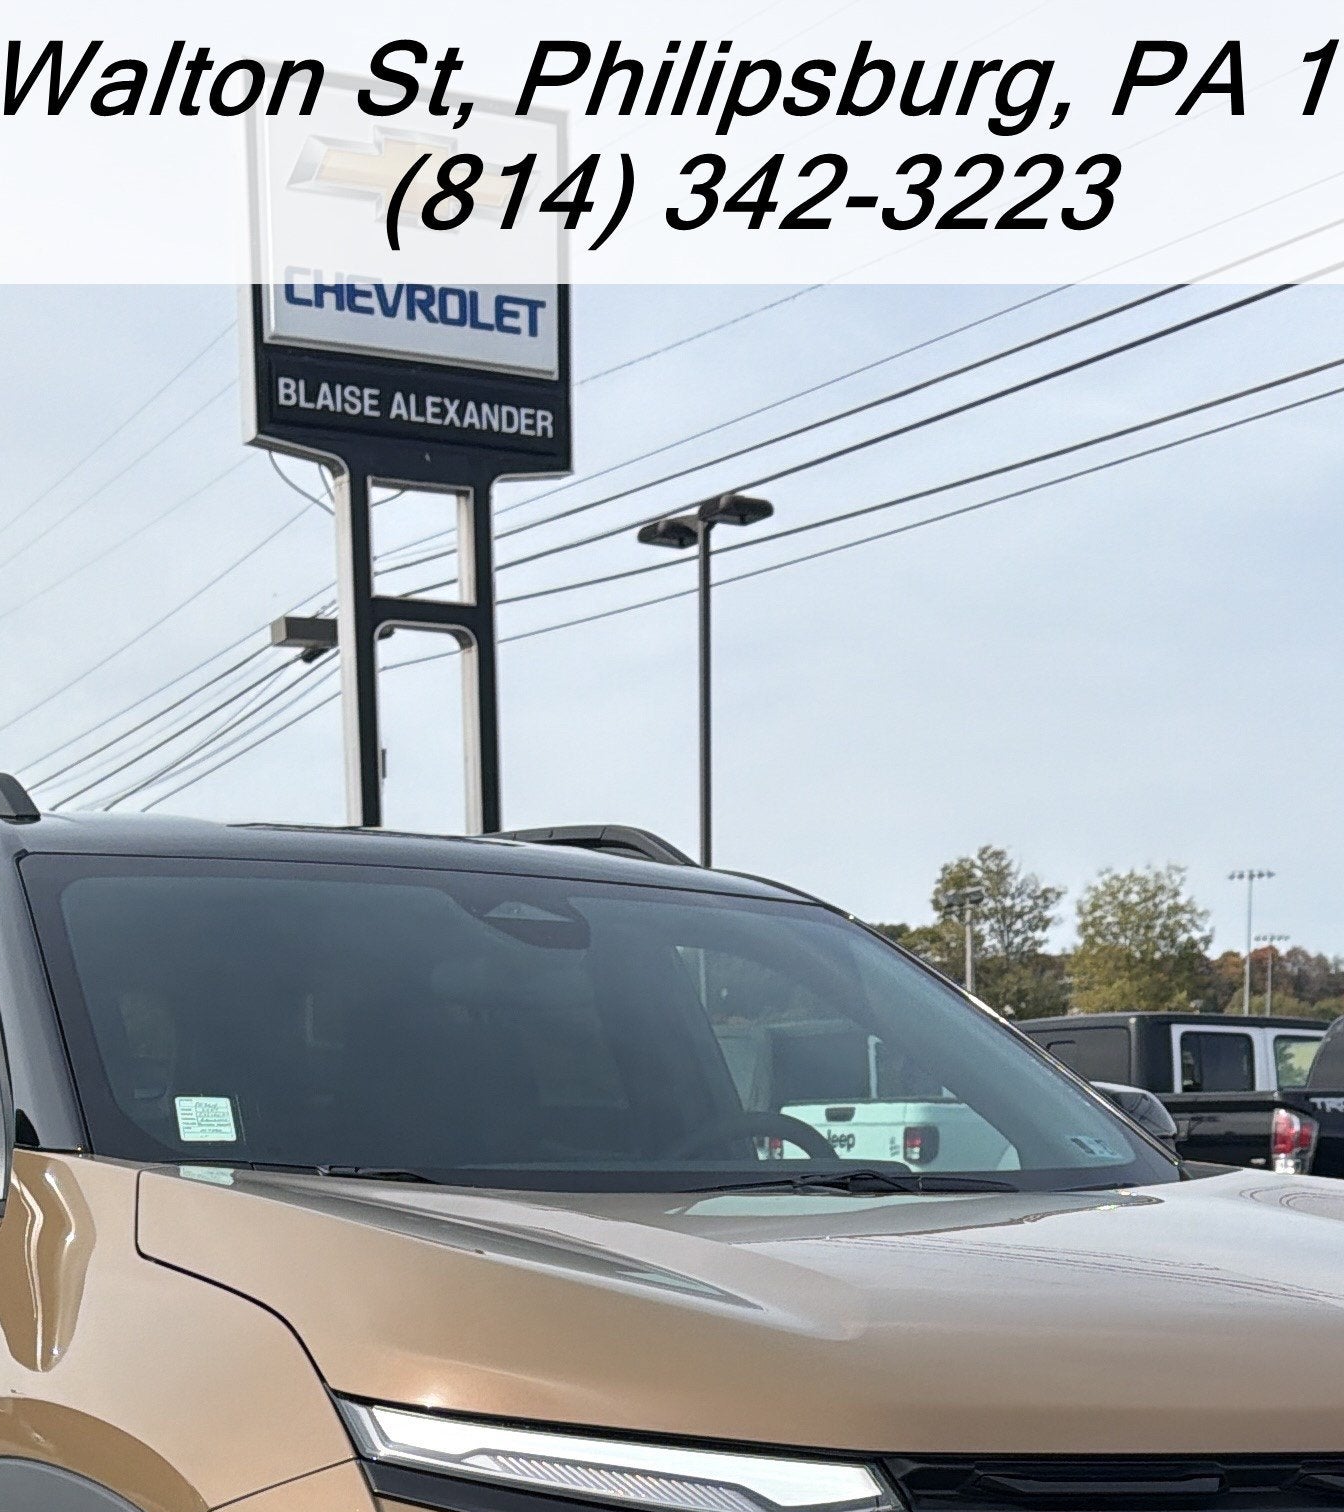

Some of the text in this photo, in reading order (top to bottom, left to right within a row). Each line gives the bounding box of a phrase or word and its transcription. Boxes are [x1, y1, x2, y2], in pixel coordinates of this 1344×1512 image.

[284, 265, 547, 338] CHEVROLET
[277, 376, 555, 439] BLAISE ALEXANDER
